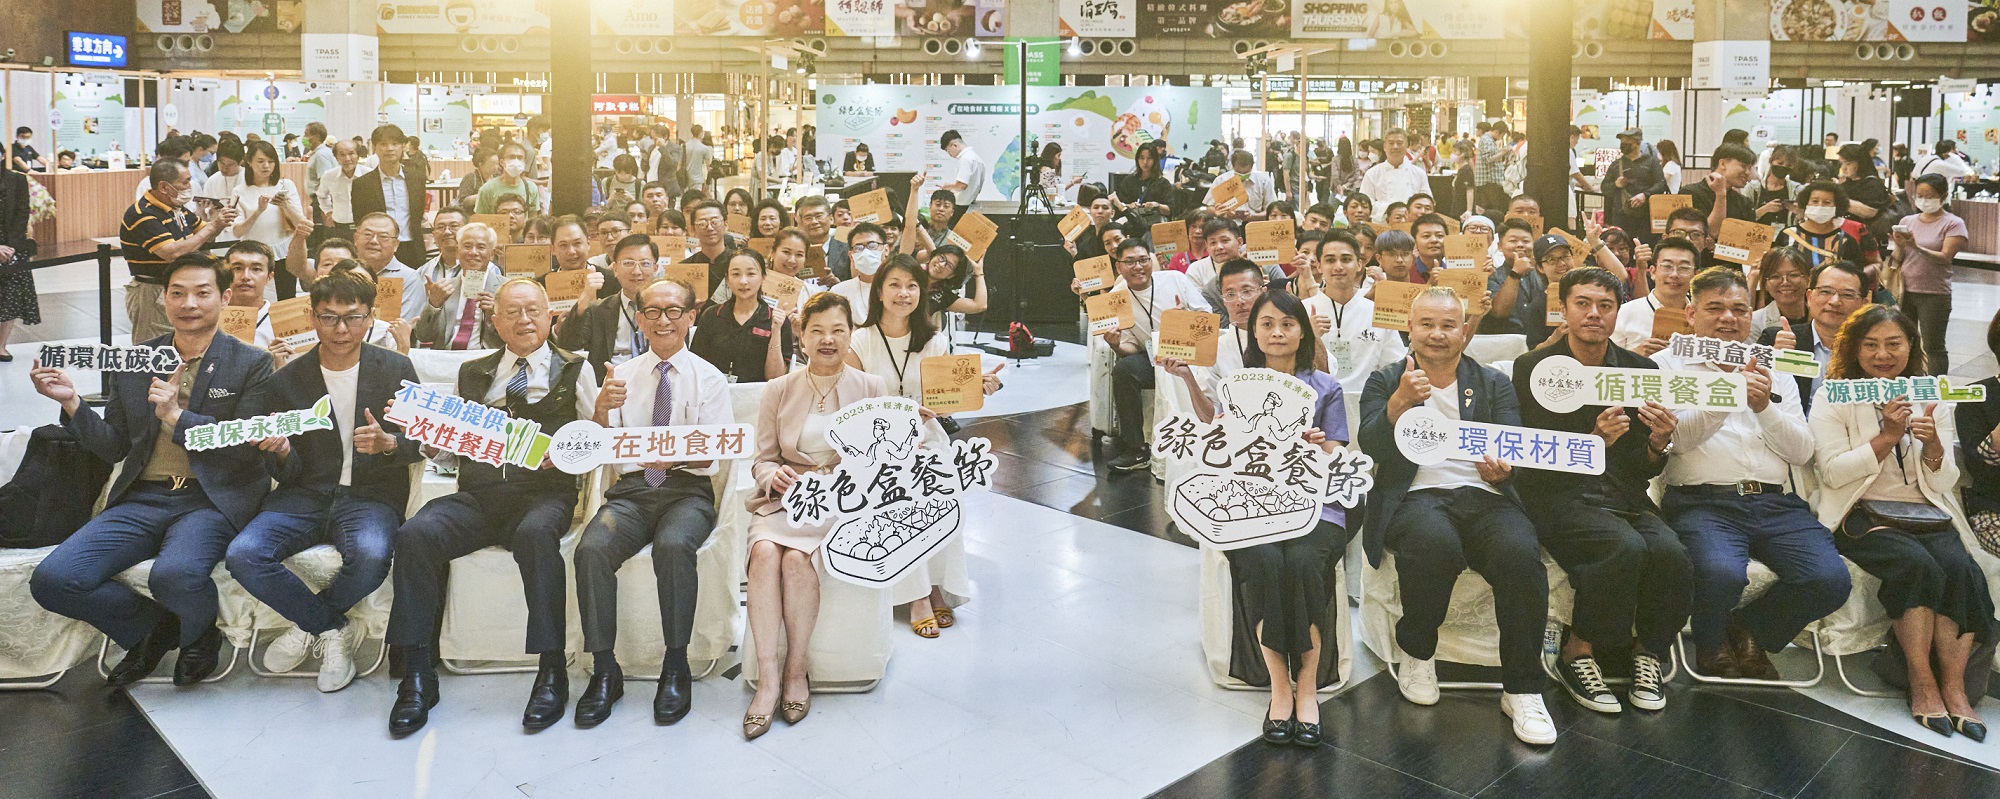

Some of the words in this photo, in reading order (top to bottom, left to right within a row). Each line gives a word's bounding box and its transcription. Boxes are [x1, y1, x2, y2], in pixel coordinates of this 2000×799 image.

[623, 9, 658, 22] Amo
[1147, 4, 1207, 12] 精緻韓式料理
[1303, 2, 1368, 15] SHOPPING
[1157, 17, 1196, 25] 第一品牌
[1302, 15, 1365, 26] THURSDAY
[72, 36, 112, 55] 乘車方向
[513, 77, 548, 88] Breeze
[223, 318, 250, 326] 綠色盒餐
[1189, 323, 1214, 334] 綠色盒餐
[40, 345, 150, 373] 循環低碳
[1671, 335, 1775, 370] 循環盒餐
[951, 366, 977, 375] 綠色盒餐
[1537, 376, 1585, 390] 綠色盒餐節
[1595, 371, 1739, 409] 循環餐盒
[1826, 379, 1939, 404] 源頭減量
[398, 383, 507, 433] 不主動提供
[188, 410, 304, 449] 環保永續
[1402, 428, 1448, 441] 綠色盒餐節
[386, 414, 506, 466] 一次性餐具
[556, 440, 603, 454] 綠色盒餐節
[612, 427, 746, 459] 在地食材
[1458, 427, 1596, 469] 環保材質
[1157, 415, 1366, 502] 綠色盒餐節
[787, 443, 993, 523] 綠色盒餐節
